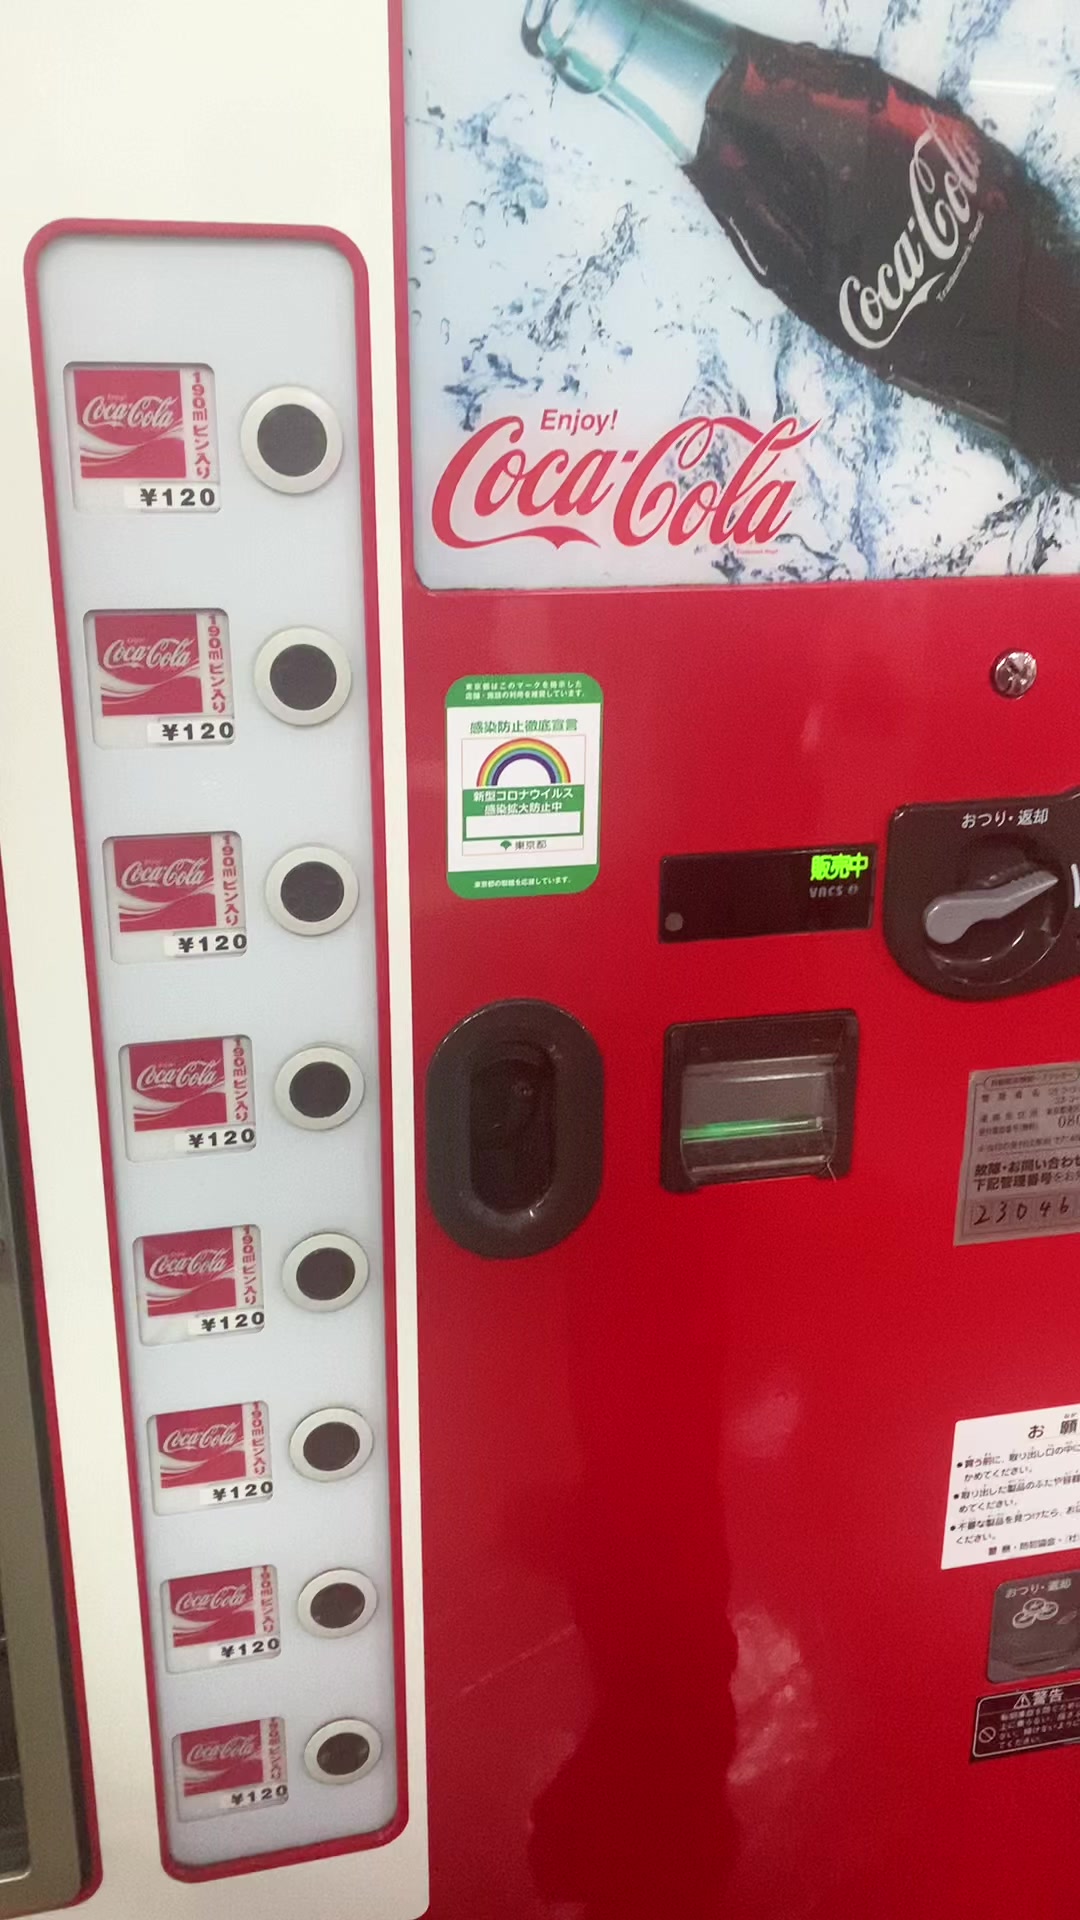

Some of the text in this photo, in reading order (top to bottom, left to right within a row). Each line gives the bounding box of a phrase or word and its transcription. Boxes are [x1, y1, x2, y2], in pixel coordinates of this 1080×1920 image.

[839, 107, 981, 349] Coca-Cola
[82, 395, 178, 428] Coca-Cola
[540, 408, 618, 436] Enjoy!
[432, 415, 822, 549] Coca-Cola
[140, 488, 216, 506] ¥120
[103, 638, 195, 669] Coca-Cola
[162, 722, 234, 741] ¥120
[470, 719, 578, 734] 感染防止徹底宣言
[473, 788, 574, 802] 新型コロナウイルス
[484, 801, 562, 815] 感染拡大防止中
[961, 808, 1048, 828] おつり・返却
[515, 840, 547, 851] 東京都
[121, 857, 210, 889] Coca-Cola
[810, 852, 868, 881] 販売中
[178, 934, 247, 953] ¥120
[136, 1058, 221, 1091] Coca-Cola
[189, 1129, 255, 1148] ¥120
[149, 1247, 231, 1279] Coca-Cola
[201, 1312, 264, 1332] ¥120
[163, 1421, 240, 1453] Coca-Cola
[213, 1482, 273, 1501] ¥120
[222, 1638, 279, 1657] ¥120
[232, 1785, 288, 1805] ¥120
